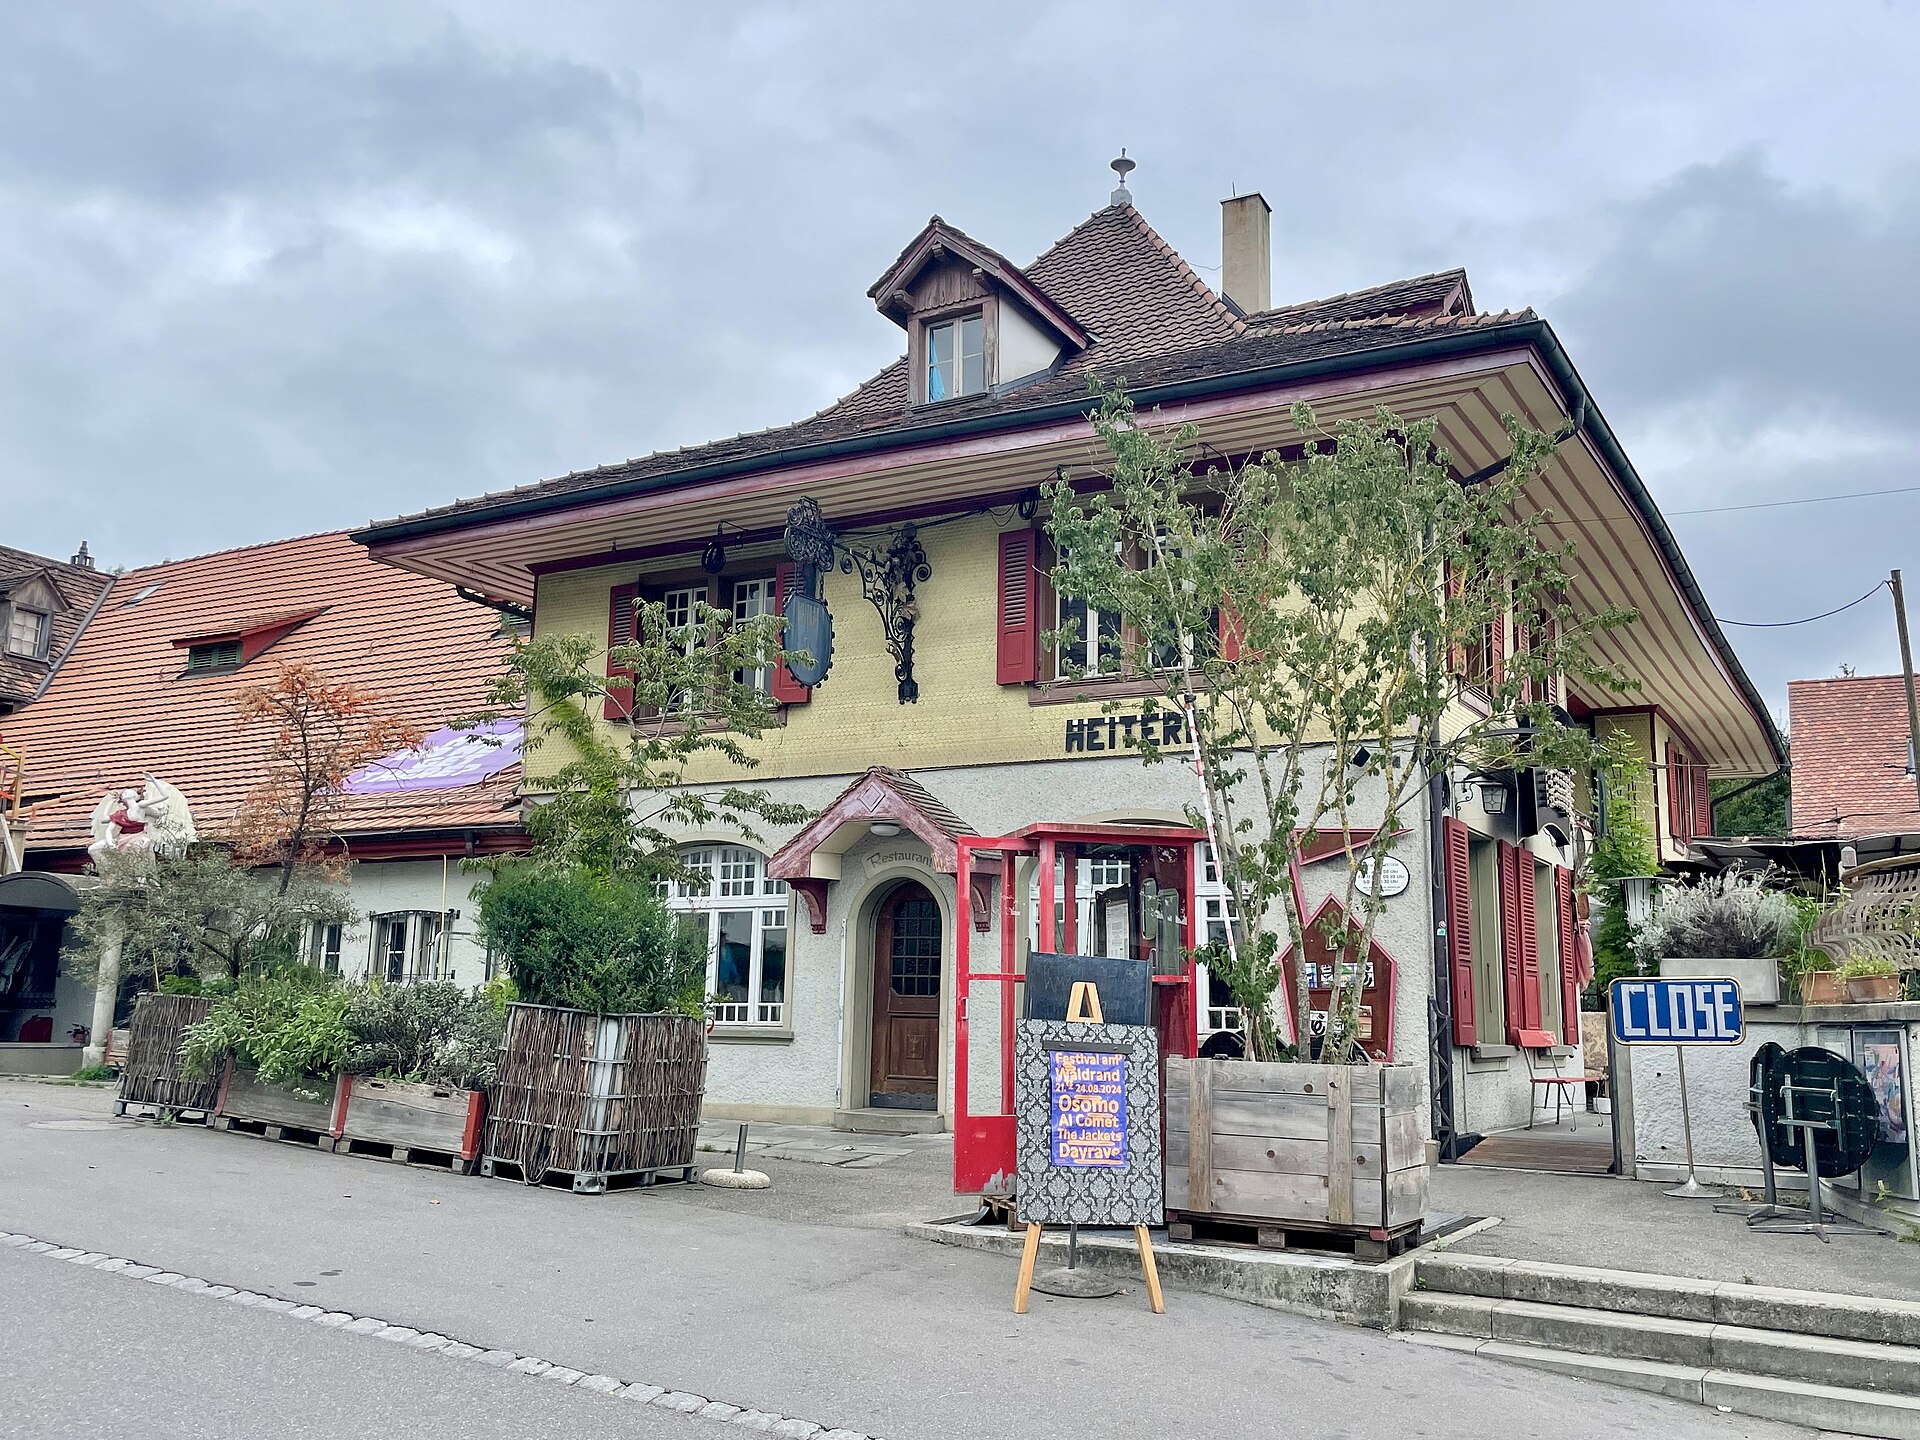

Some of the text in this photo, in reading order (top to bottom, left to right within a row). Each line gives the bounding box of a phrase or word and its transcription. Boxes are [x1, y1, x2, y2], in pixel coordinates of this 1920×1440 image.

[1620, 984, 1737, 1038] CLOSE
[1055, 1052, 1119, 1066] Festival am
[1055, 1067, 1120, 1082] Waldrand
[1075, 1084, 1122, 1094] 24.08.2024
[1075, 1114, 1119, 1128] Comet
[1057, 1128, 1122, 1141] The Jackets
[1059, 1142, 1120, 1160] Dayrave
